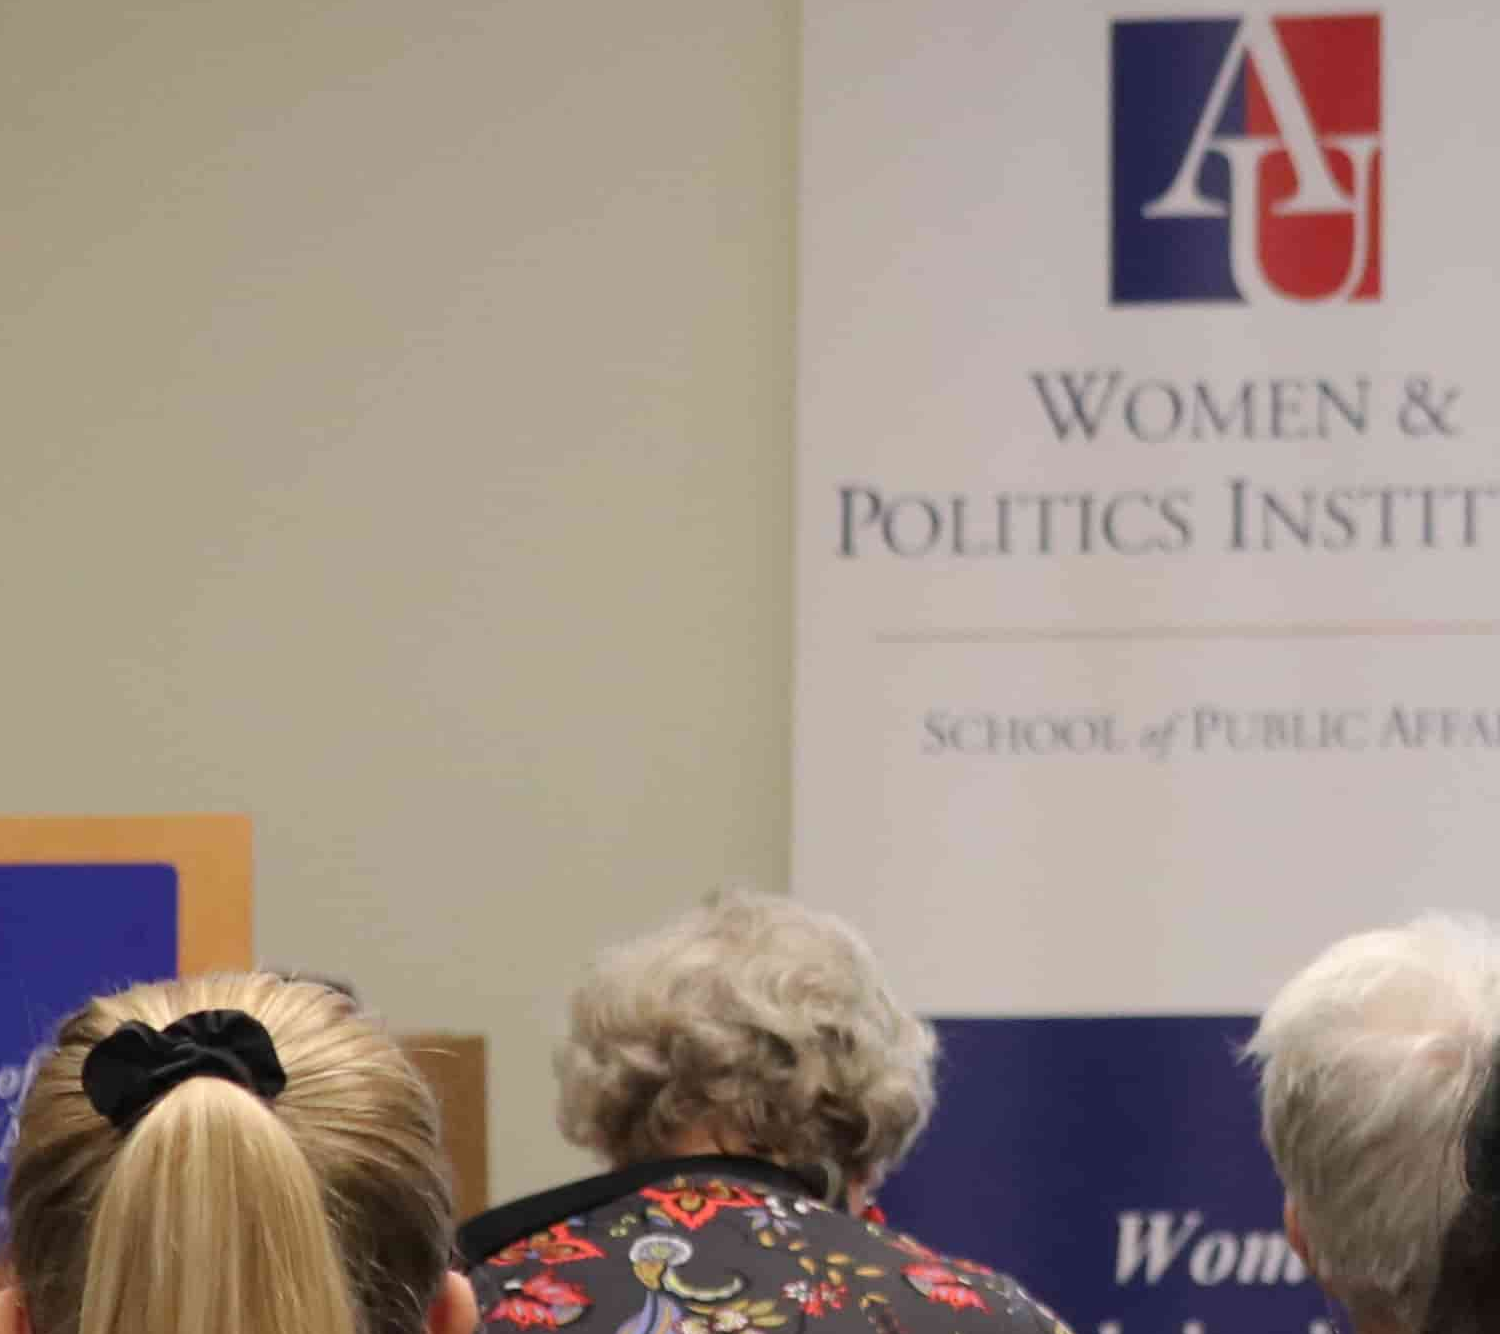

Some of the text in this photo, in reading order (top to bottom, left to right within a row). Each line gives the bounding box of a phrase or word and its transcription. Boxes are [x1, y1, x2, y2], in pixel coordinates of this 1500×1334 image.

[1030, 370, 1461, 441] WOMEN &
[835, 485, 1194, 559] POLITICS
[922, 706, 1126, 757] SCHOOL
[1139, 710, 1182, 762] of
[1193, 704, 1370, 752] PUBLIC
[1114, 1210, 1308, 1286] Wom
